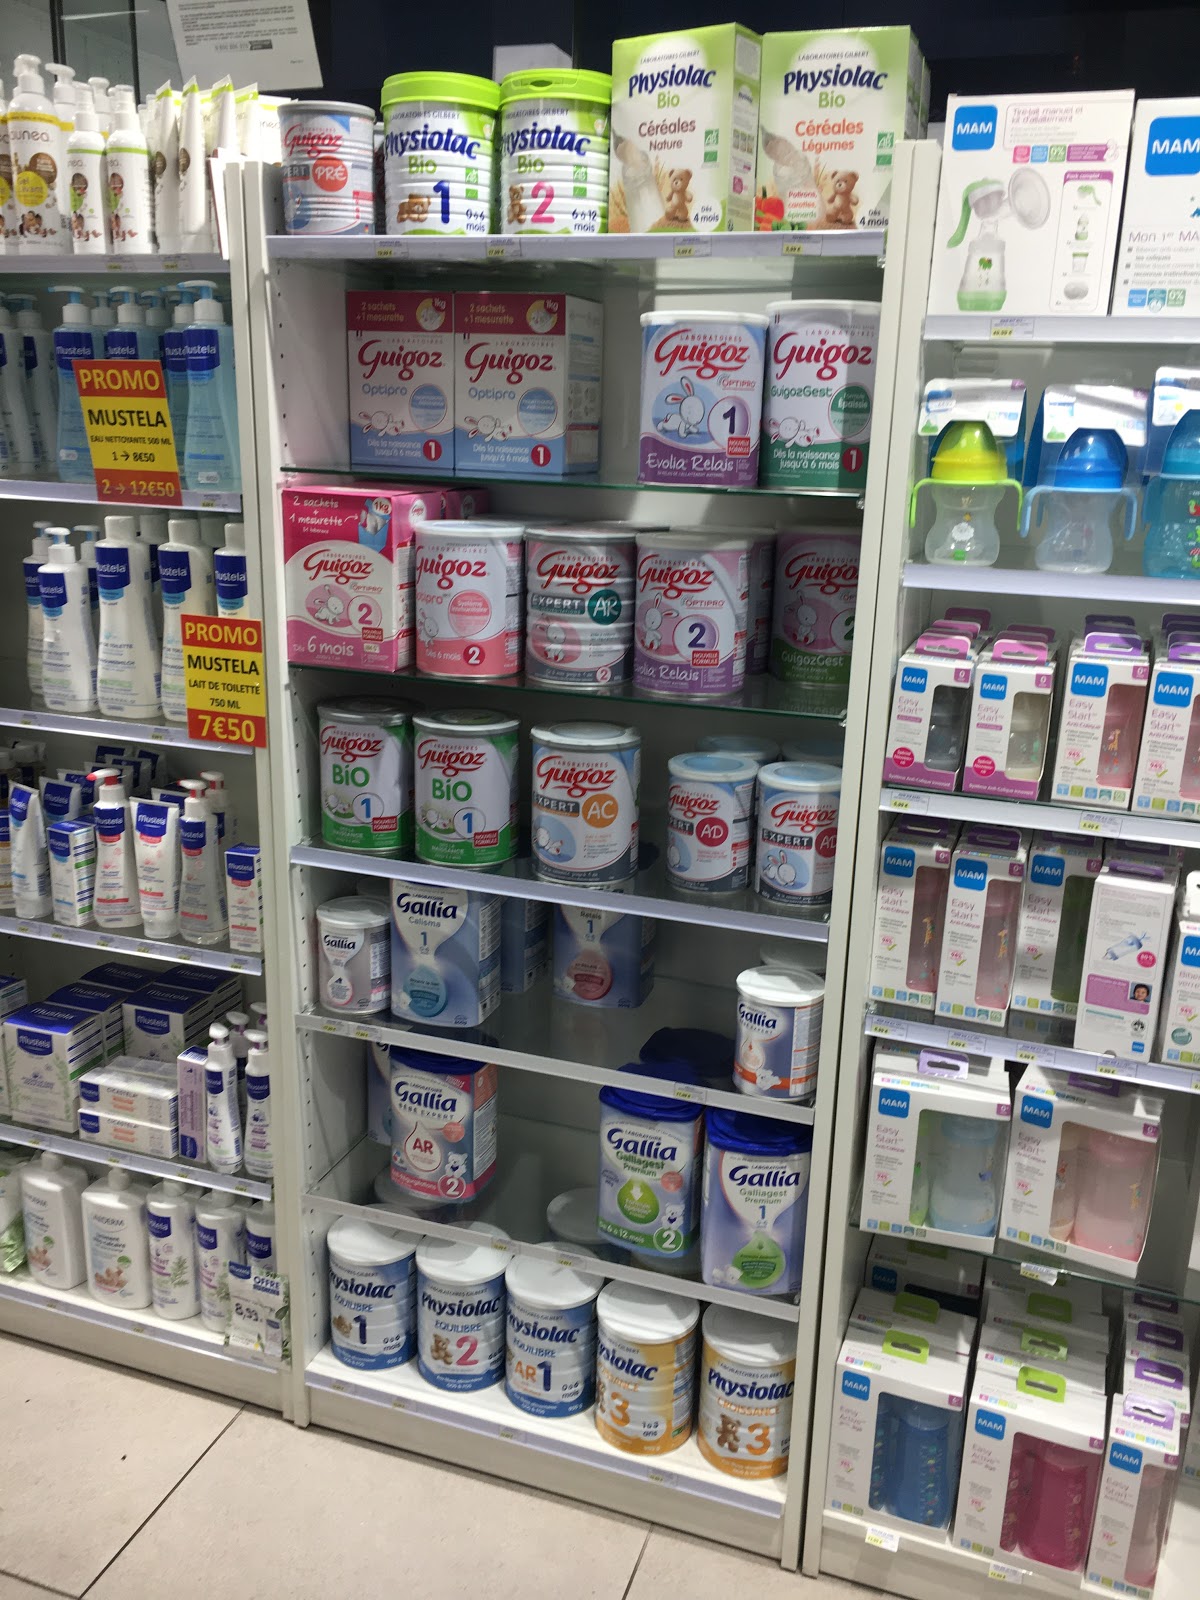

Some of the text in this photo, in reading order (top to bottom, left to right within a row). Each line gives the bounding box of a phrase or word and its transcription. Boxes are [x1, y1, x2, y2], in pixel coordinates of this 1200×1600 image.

[838, 51, 869, 59] GILBERT
[628, 64, 717, 97] Physiolac
[784, 64, 888, 95] Physiolac
[657, 92, 680, 109] Bio
[818, 91, 845, 108] Bio
[638, 117, 696, 137] Céréales
[795, 120, 864, 137] Céréales
[956, 122, 993, 135] MAM
[284, 124, 344, 157] Guigoz
[649, 139, 682, 150] Nature
[802, 139, 855, 155] Légumes
[409, 155, 437, 174] Bio
[518, 154, 544, 174] Bio
[433, 180, 450, 224] 1
[531, 181, 554, 223] 2
[701, 213, 719, 222] mois
[574, 222, 595, 232] mois
[368, 302, 396, 312] sachets
[476, 304, 506, 314] sachets
[680, 334, 743, 343] LABORATOIRES
[357, 339, 443, 381] Guigoz
[654, 329, 750, 380] Guigoz
[773, 332, 872, 380] Guigoz
[464, 342, 554, 385] Guigoz
[79, 369, 160, 390] PROMO
[362, 383, 408, 397] Optipro
[468, 386, 516, 401] Optipro
[771, 385, 833, 399] GuigozGest
[88, 409, 167, 428] MUSTELA
[722, 406, 736, 434] 1
[90, 435, 104, 443] EAU
[104, 436, 146, 445] NETTOYANTE
[147, 437, 160, 445] 500
[386, 440, 421, 449] naissance
[112, 451, 155, 462] 1 8€50
[429, 442, 436, 459] 1
[493, 445, 529, 454] naissance
[537, 447, 545, 464] 1
[773, 450, 840, 461] Dès la naissance
[513, 454, 529, 463] mois
[646, 453, 734, 472] Evolia Relais
[779, 460, 840, 470] jusqu'à 6 mois
[849, 450, 857, 469] 1
[102, 479, 175, 498] 2 12€50
[293, 497, 338, 508] 2 sachets
[298, 515, 343, 526] mesurette
[303, 549, 373, 585] Guigoz
[536, 551, 620, 594] Guigoz
[637, 553, 714, 600] Guigoz
[593, 597, 619, 617] AR
[685, 599, 724, 608] OPTIPRO
[358, 603, 372, 625] 2
[185, 622, 258, 646] PROMO
[687, 622, 706, 648] 2
[308, 636, 354, 657] 6 mois
[468, 647, 480, 664] 2
[187, 654, 259, 675] MUSTELA
[600, 671, 608, 680] 2
[659, 664, 699, 682] Relais
[903, 676, 925, 686] MAM
[1074, 674, 1105, 687] MAM
[188, 679, 260, 695] LAIT DE TOILETTE
[982, 682, 1005, 693] MAM
[1157, 684, 1190, 696] MAM
[210, 698, 241, 709] 750 ML
[897, 705, 918, 714] Start
[898, 696, 919, 707] Easy
[977, 704, 999, 715] Easy
[1069, 699, 1094, 711] Easy
[976, 712, 998, 722] Start
[1068, 710, 1091, 720] Start
[1152, 708, 1177, 721] Easy
[198, 714, 256, 743] 7€50
[1150, 719, 1175, 730] Start
[320, 725, 383, 763] Guigoz
[417, 739, 486, 777] Guigoz
[536, 755, 615, 798] Guigoz
[360, 798, 371, 818] 1
[586, 800, 615, 820] AC
[137, 815, 167, 825] Mustela
[462, 812, 473, 834] 1
[770, 800, 837, 833] Guigoz
[762, 831, 810, 846] EXPERT
[885, 857, 912, 869] MAM
[1034, 865, 1062, 877] MAM
[956, 869, 985, 881] MAM
[881, 885, 904, 898] Easy
[396, 893, 458, 920] Gallia
[951, 898, 975, 911] Easy
[1027, 893, 1052, 907] Easy
[408, 916, 441, 928] Calisma
[950, 909, 973, 920] Start
[586, 920, 594, 934] 1
[323, 934, 356, 950] Gallia
[420, 932, 428, 946] 1
[31, 1006, 75, 1020] Mustela
[738, 1002, 778, 1030] Gallia
[137, 1016, 169, 1028] Mustela
[19, 1034, 51, 1049] Mustela
[395, 1081, 457, 1112] Gallia
[881, 1097, 907, 1110] MAM
[1023, 1106, 1050, 1120] MAM
[876, 1124, 900, 1137] Easy
[413, 1138, 433, 1155] AR
[607, 1128, 677, 1162] Gallia
[1018, 1132, 1042, 1146] Easy
[616, 1151, 665, 1169] Galliagest
[623, 1162, 657, 1178] Premium
[728, 1165, 801, 1188] Gallia
[446, 1179, 459, 1195] 2
[739, 1189, 787, 1198] Galliagest
[744, 1197, 782, 1205] Premium
[758, 1205, 766, 1219] 1
[662, 1233, 676, 1249] 2
[253, 1275, 281, 1289] OFFRE
[422, 1291, 499, 1318] Physiolac
[353, 1314, 367, 1345] 1
[455, 1335, 479, 1366] 2
[514, 1361, 537, 1383] AR
[537, 1361, 552, 1391] 1
[708, 1368, 795, 1400] Physiolac
[843, 1381, 869, 1393] MAM
[610, 1392, 631, 1428] 3
[976, 1420, 1003, 1434] MAM
[746, 1422, 771, 1455] 3
[1112, 1450, 1140, 1466] MAM
